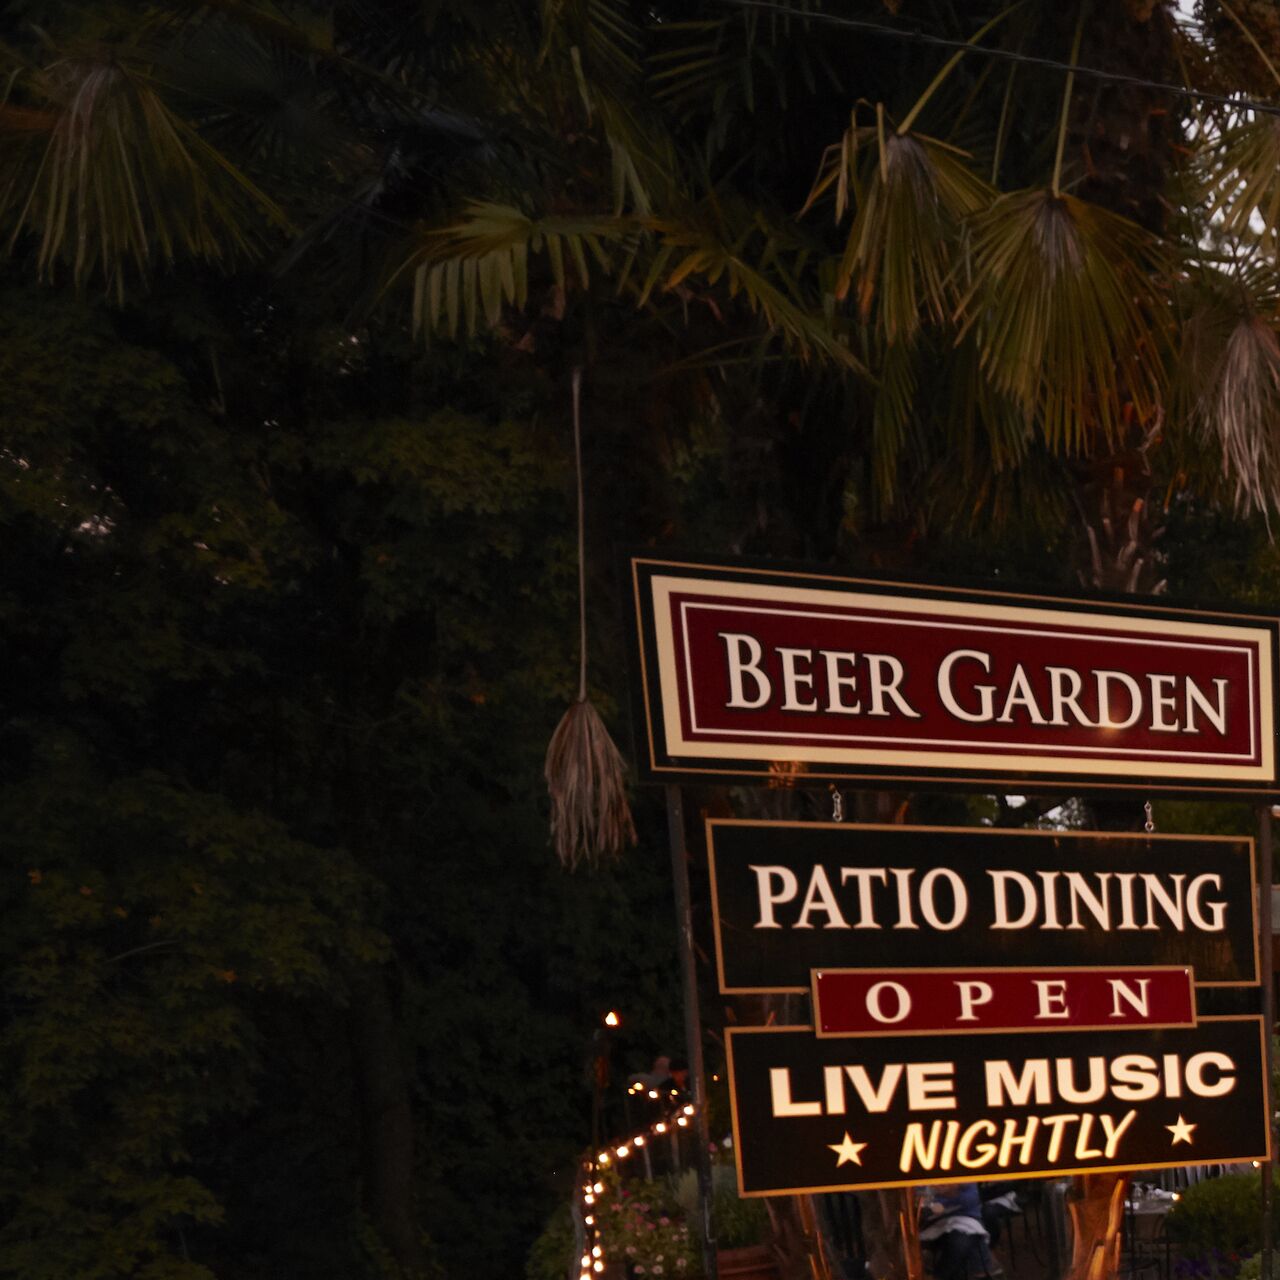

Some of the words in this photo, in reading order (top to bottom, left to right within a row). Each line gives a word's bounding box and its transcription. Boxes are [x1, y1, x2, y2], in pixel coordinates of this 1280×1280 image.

[718, 632, 921, 718] BEER
[937, 648, 1229, 736] GARDEN
[749, 864, 969, 931] PATIO
[986, 870, 1228, 933] DINING
[865, 979, 1151, 1024] OPEN
[769, 1062, 957, 1118] LIVE
[984, 1050, 1237, 1107] MUSIC
[899, 1108, 1137, 1174] NIGHTLY
